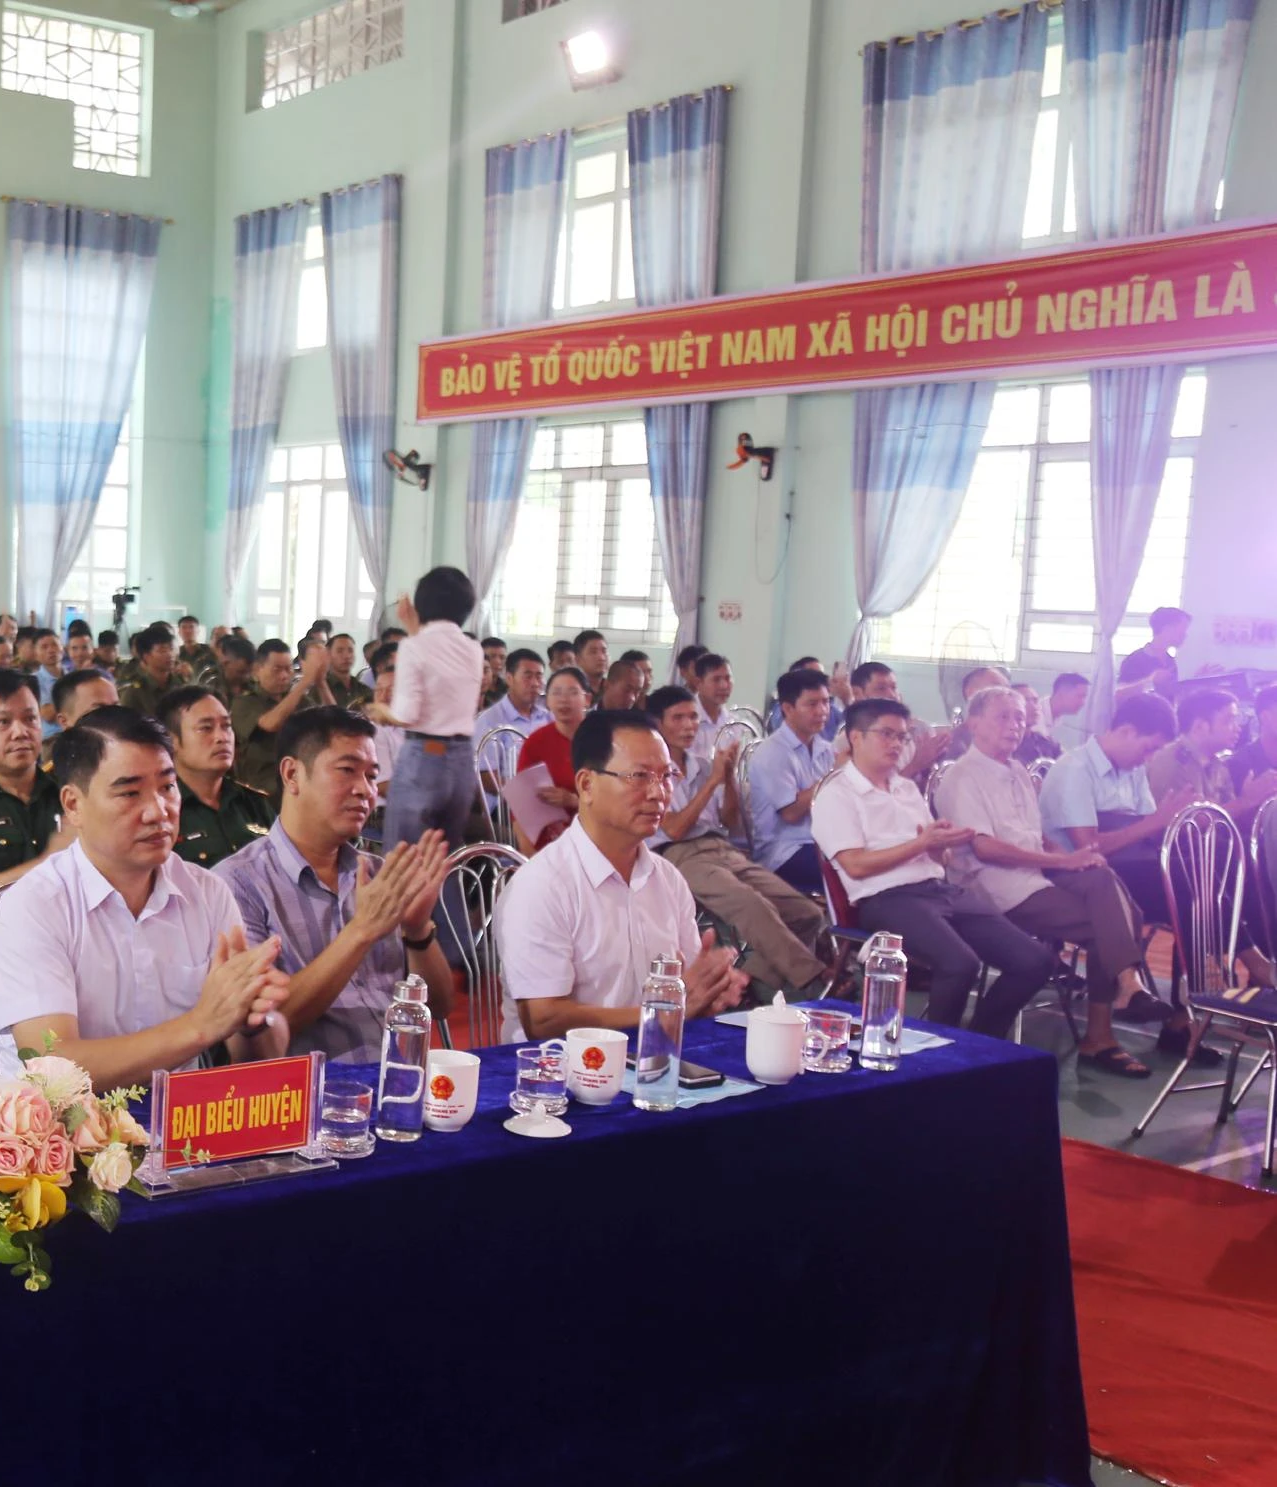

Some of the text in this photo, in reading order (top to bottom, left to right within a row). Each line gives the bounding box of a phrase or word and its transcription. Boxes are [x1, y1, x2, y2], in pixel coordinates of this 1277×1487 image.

[440, 354, 486, 397] BẢO
[493, 353, 522, 396] VỆ
[530, 340, 563, 387] TỔ
[567, 335, 641, 386] QUỐC
[650, 330, 713, 379] VIỆT
[720, 324, 797, 367] NAM
[806, 311, 854, 359] XÃ
[865, 303, 928, 358] HỘI
[941, 280, 1022, 345] CHỦ
[1035, 273, 1178, 335] NGHĨA
[1194, 260, 1256, 319] LÀ
[205, 1084, 244, 1136] BIỂU
[248, 1083, 302, 1132] HUYỆN
